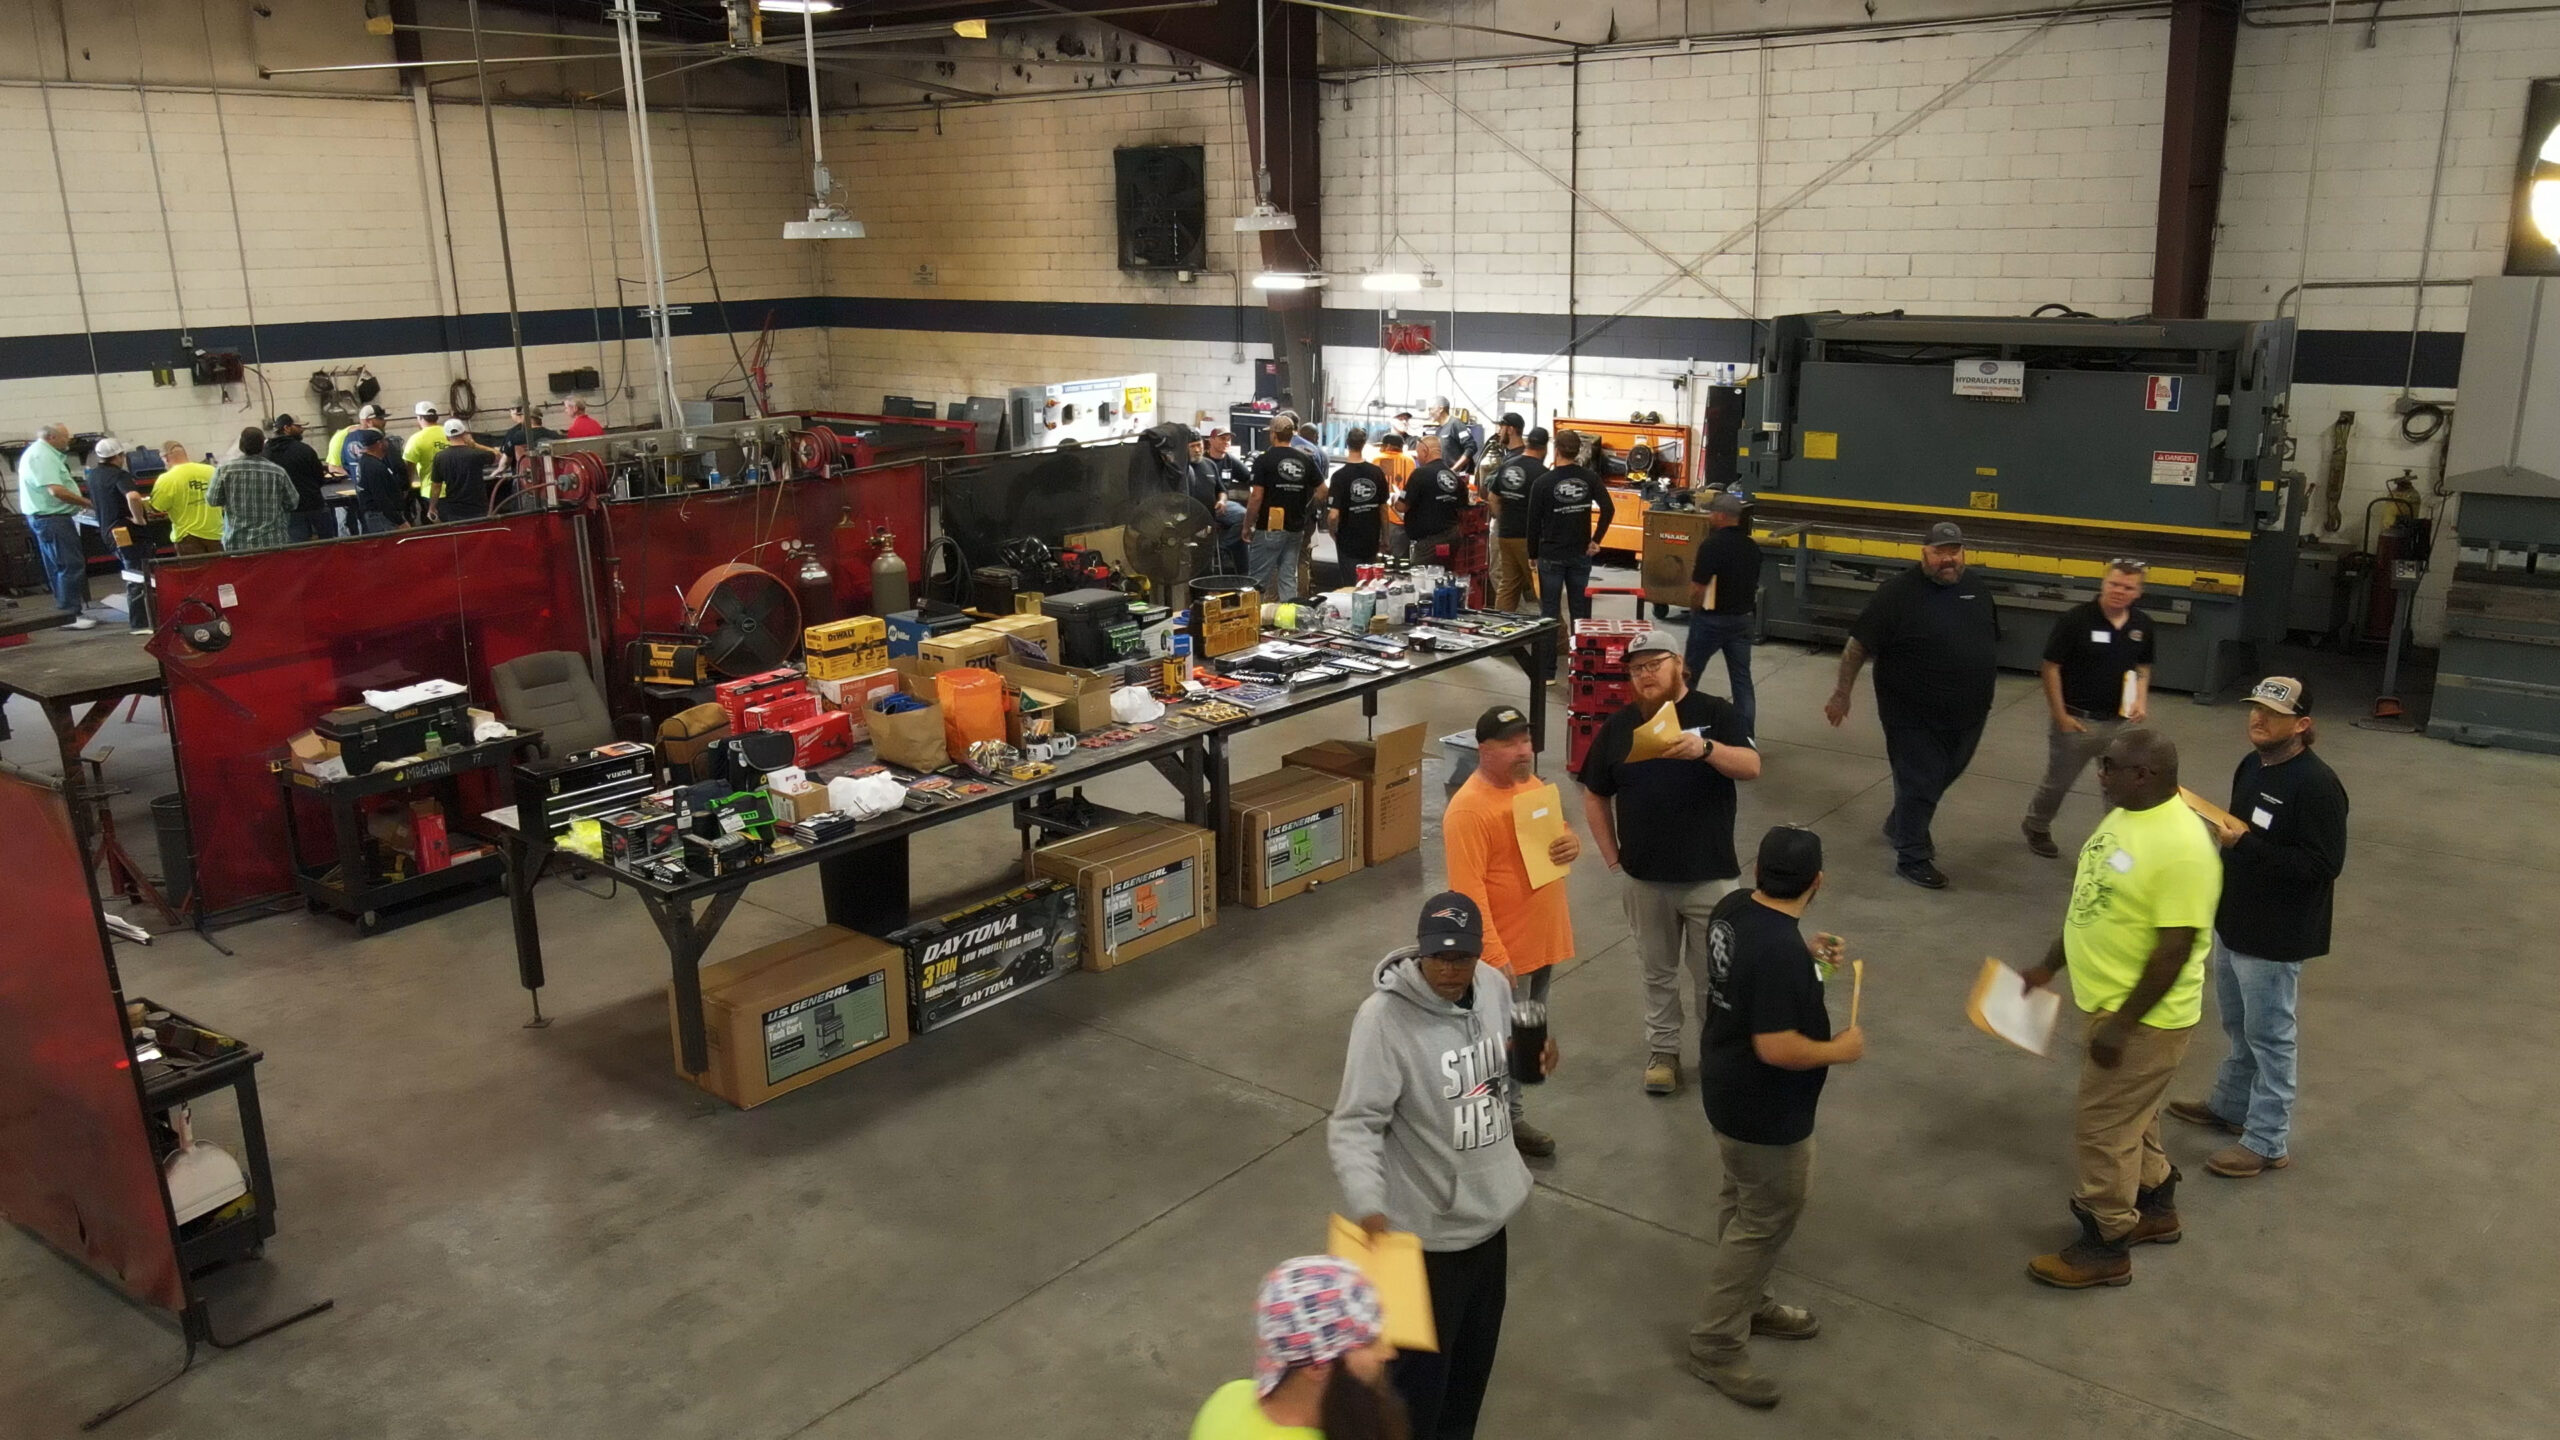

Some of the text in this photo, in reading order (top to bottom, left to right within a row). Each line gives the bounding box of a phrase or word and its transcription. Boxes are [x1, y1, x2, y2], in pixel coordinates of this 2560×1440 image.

[1955, 376, 2021, 385] HYDRAULIC PRESS
[2164, 454, 2194, 462] DANGER
[1659, 532, 1690, 541] KNAACK
[605, 768, 633, 780] YUKON
[1281, 812, 1321, 834] GENERAL
[1122, 867, 1168, 890] GENERAL
[922, 913, 1018, 965] DAYTONA
[962, 927, 1044, 964] LOW PROFILE LONG REACH
[922, 964, 936, 989] 3
[935, 955, 958, 979] TON
[789, 983, 850, 1015] GENERAL
[961, 976, 1014, 1008] DAYTONA
